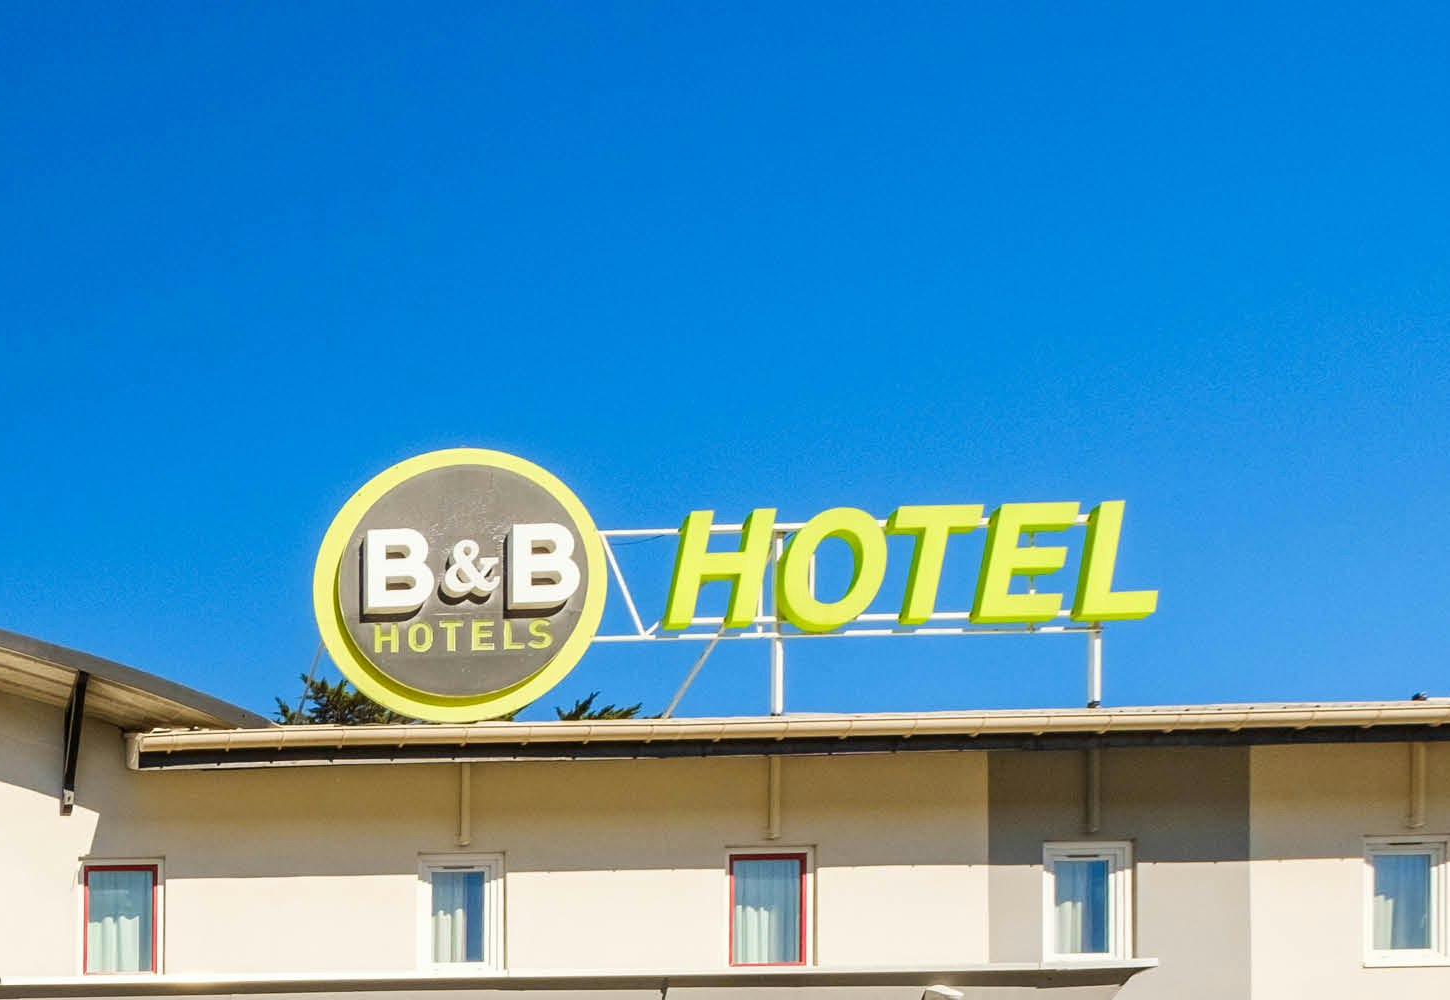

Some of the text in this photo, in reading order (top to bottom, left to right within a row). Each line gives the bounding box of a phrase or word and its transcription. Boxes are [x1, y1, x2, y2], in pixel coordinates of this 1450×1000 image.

[364, 522, 581, 616] B&B
[662, 499, 1159, 632] HOTEL
[373, 619, 554, 653] HOTELS
